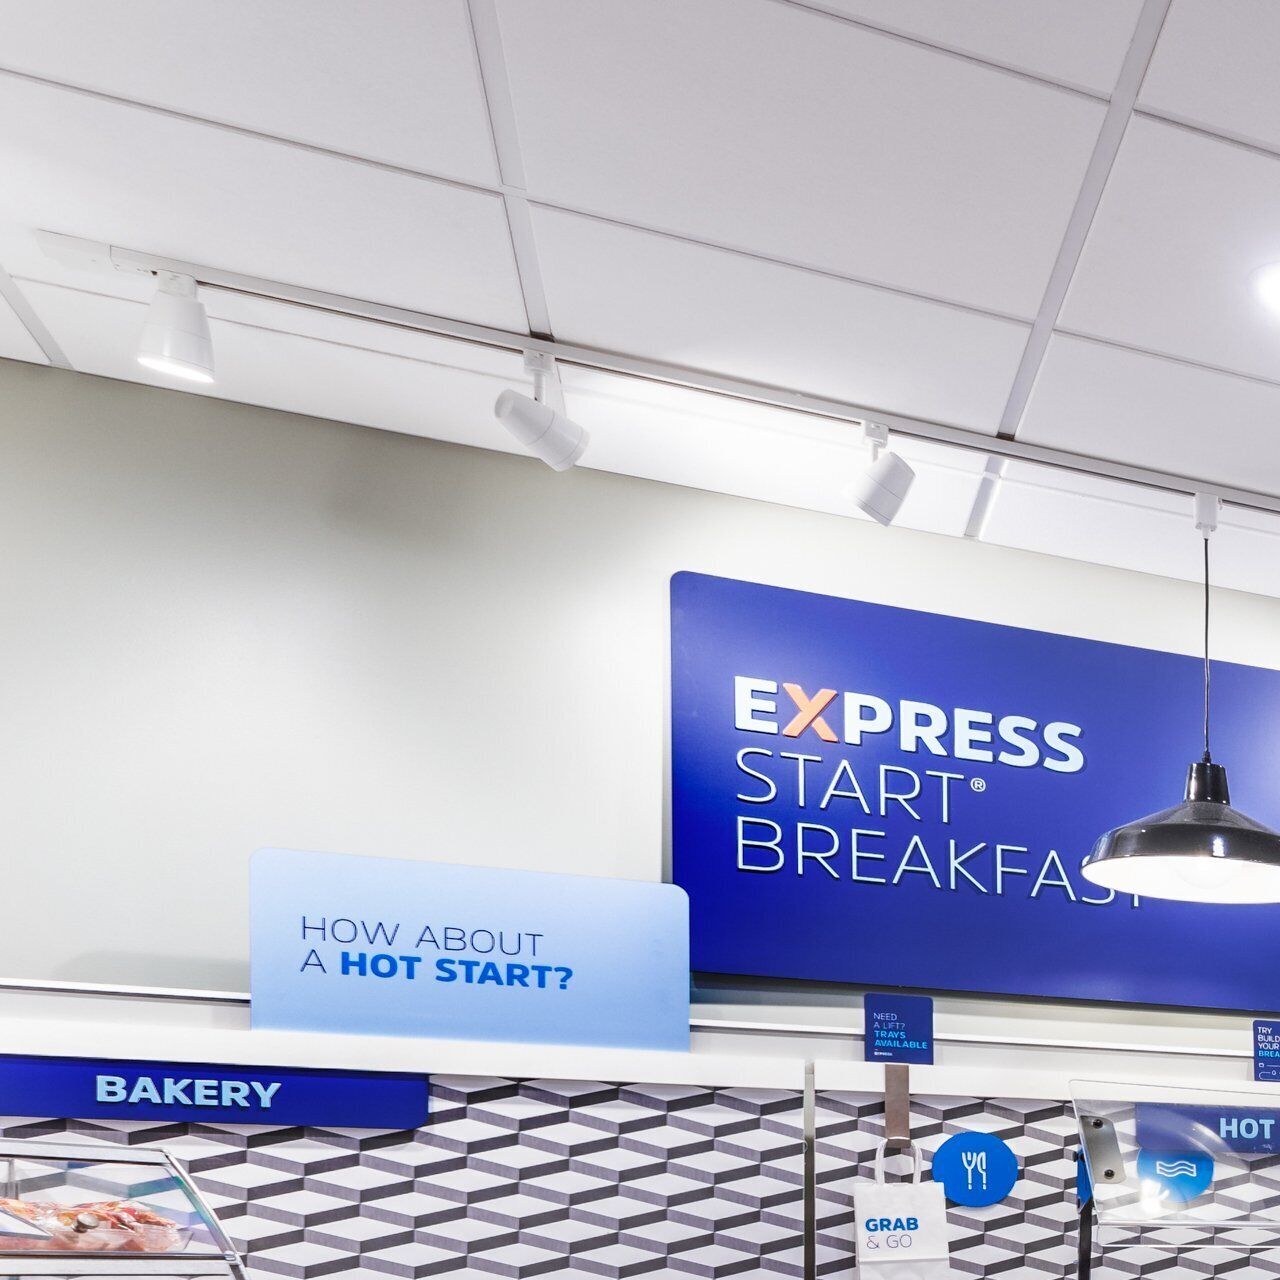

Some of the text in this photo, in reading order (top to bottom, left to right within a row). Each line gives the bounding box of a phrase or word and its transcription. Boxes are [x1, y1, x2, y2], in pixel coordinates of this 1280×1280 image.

[733, 675, 1085, 774] EXPRESS
[301, 915, 544, 956] HOW ABOUT
[300, 949, 574, 991] A HOT START?
[873, 1012, 898, 1021] NEED
[873, 1021, 881, 1029] A
[1257, 1026, 1273, 1035] TRY
[874, 1030, 907, 1039] TRAYS
[874, 1039, 928, 1050] AVAILABLE
[1257, 1042, 1280, 1050] YOUR
[95, 1074, 282, 1108] BAKERY
[1219, 1117, 1275, 1140] HOT
[865, 1217, 919, 1232] GRAB
[866, 1233, 912, 1249] & GO
